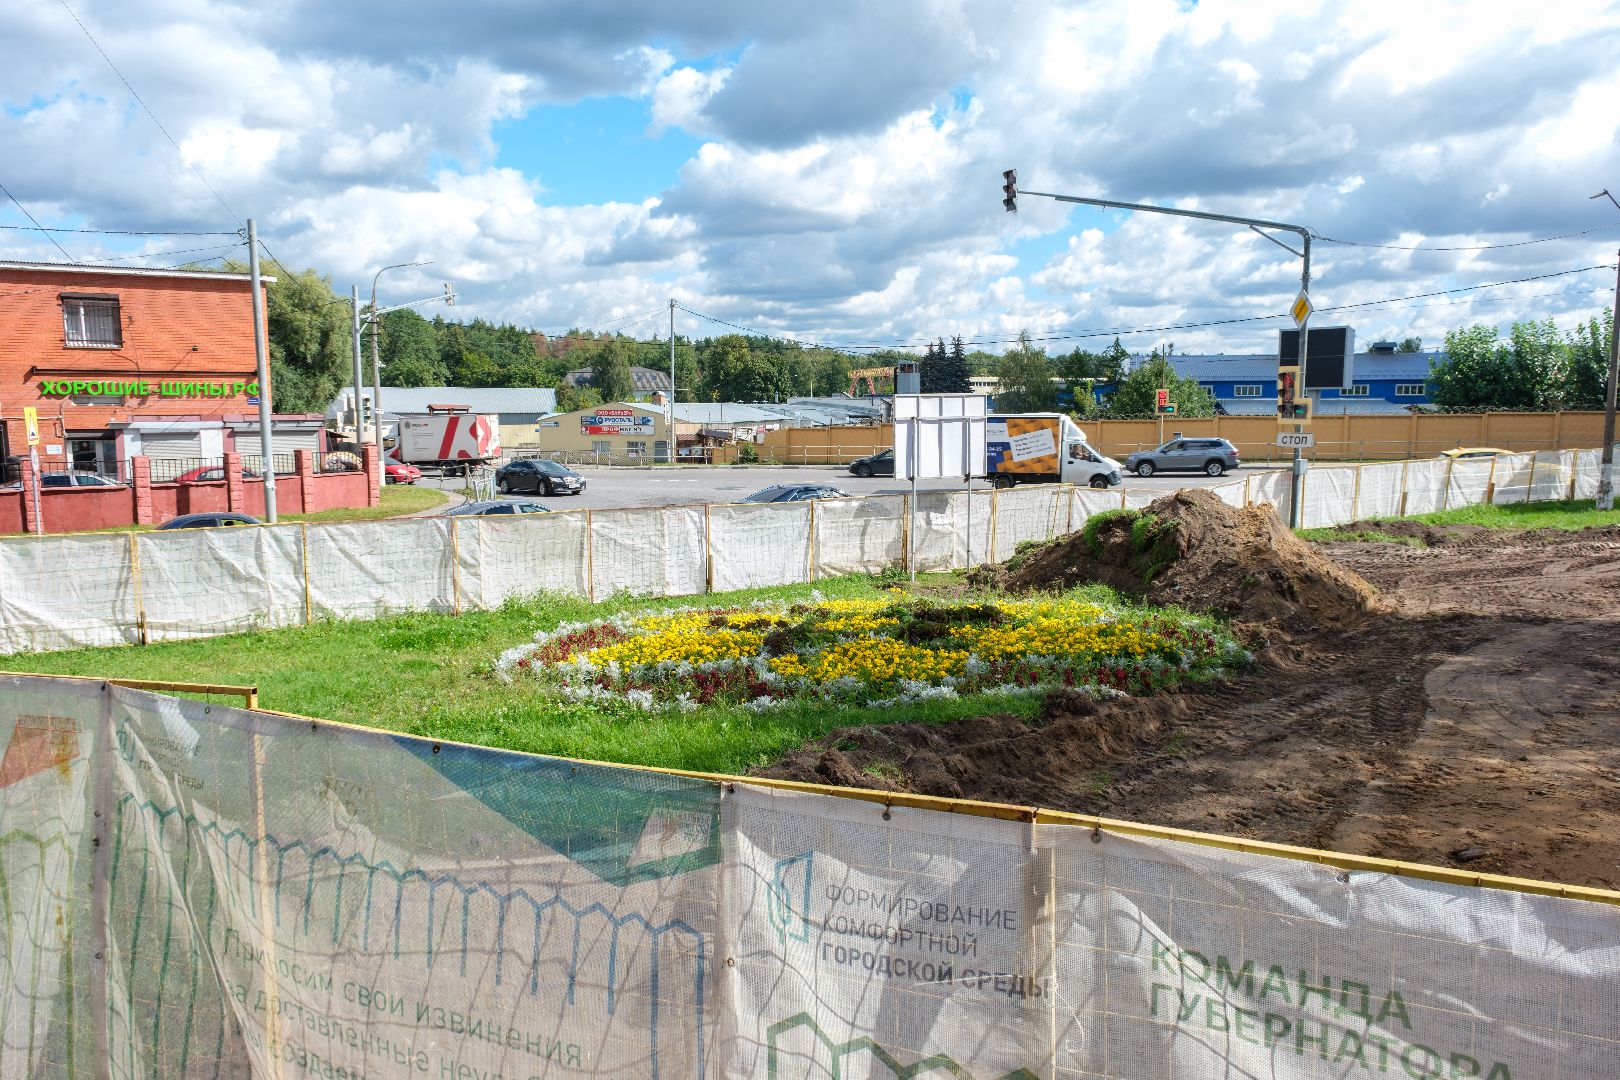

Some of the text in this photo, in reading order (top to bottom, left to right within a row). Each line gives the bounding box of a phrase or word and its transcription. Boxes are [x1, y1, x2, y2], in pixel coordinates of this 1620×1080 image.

[1281, 435, 1308, 445] СТОП
[825, 884, 1017, 930] ФОРМИРОВАНИЕ
[823, 914, 978, 958] КОМФОРТНОЙ
[822, 942, 1049, 1000] ГОРОДСКОЙ СРЕДЫ
[1151, 940, 1413, 1030] КОМАНДА
[343, 981, 405, 1018] свои
[416, 1001, 582, 1068] извинения
